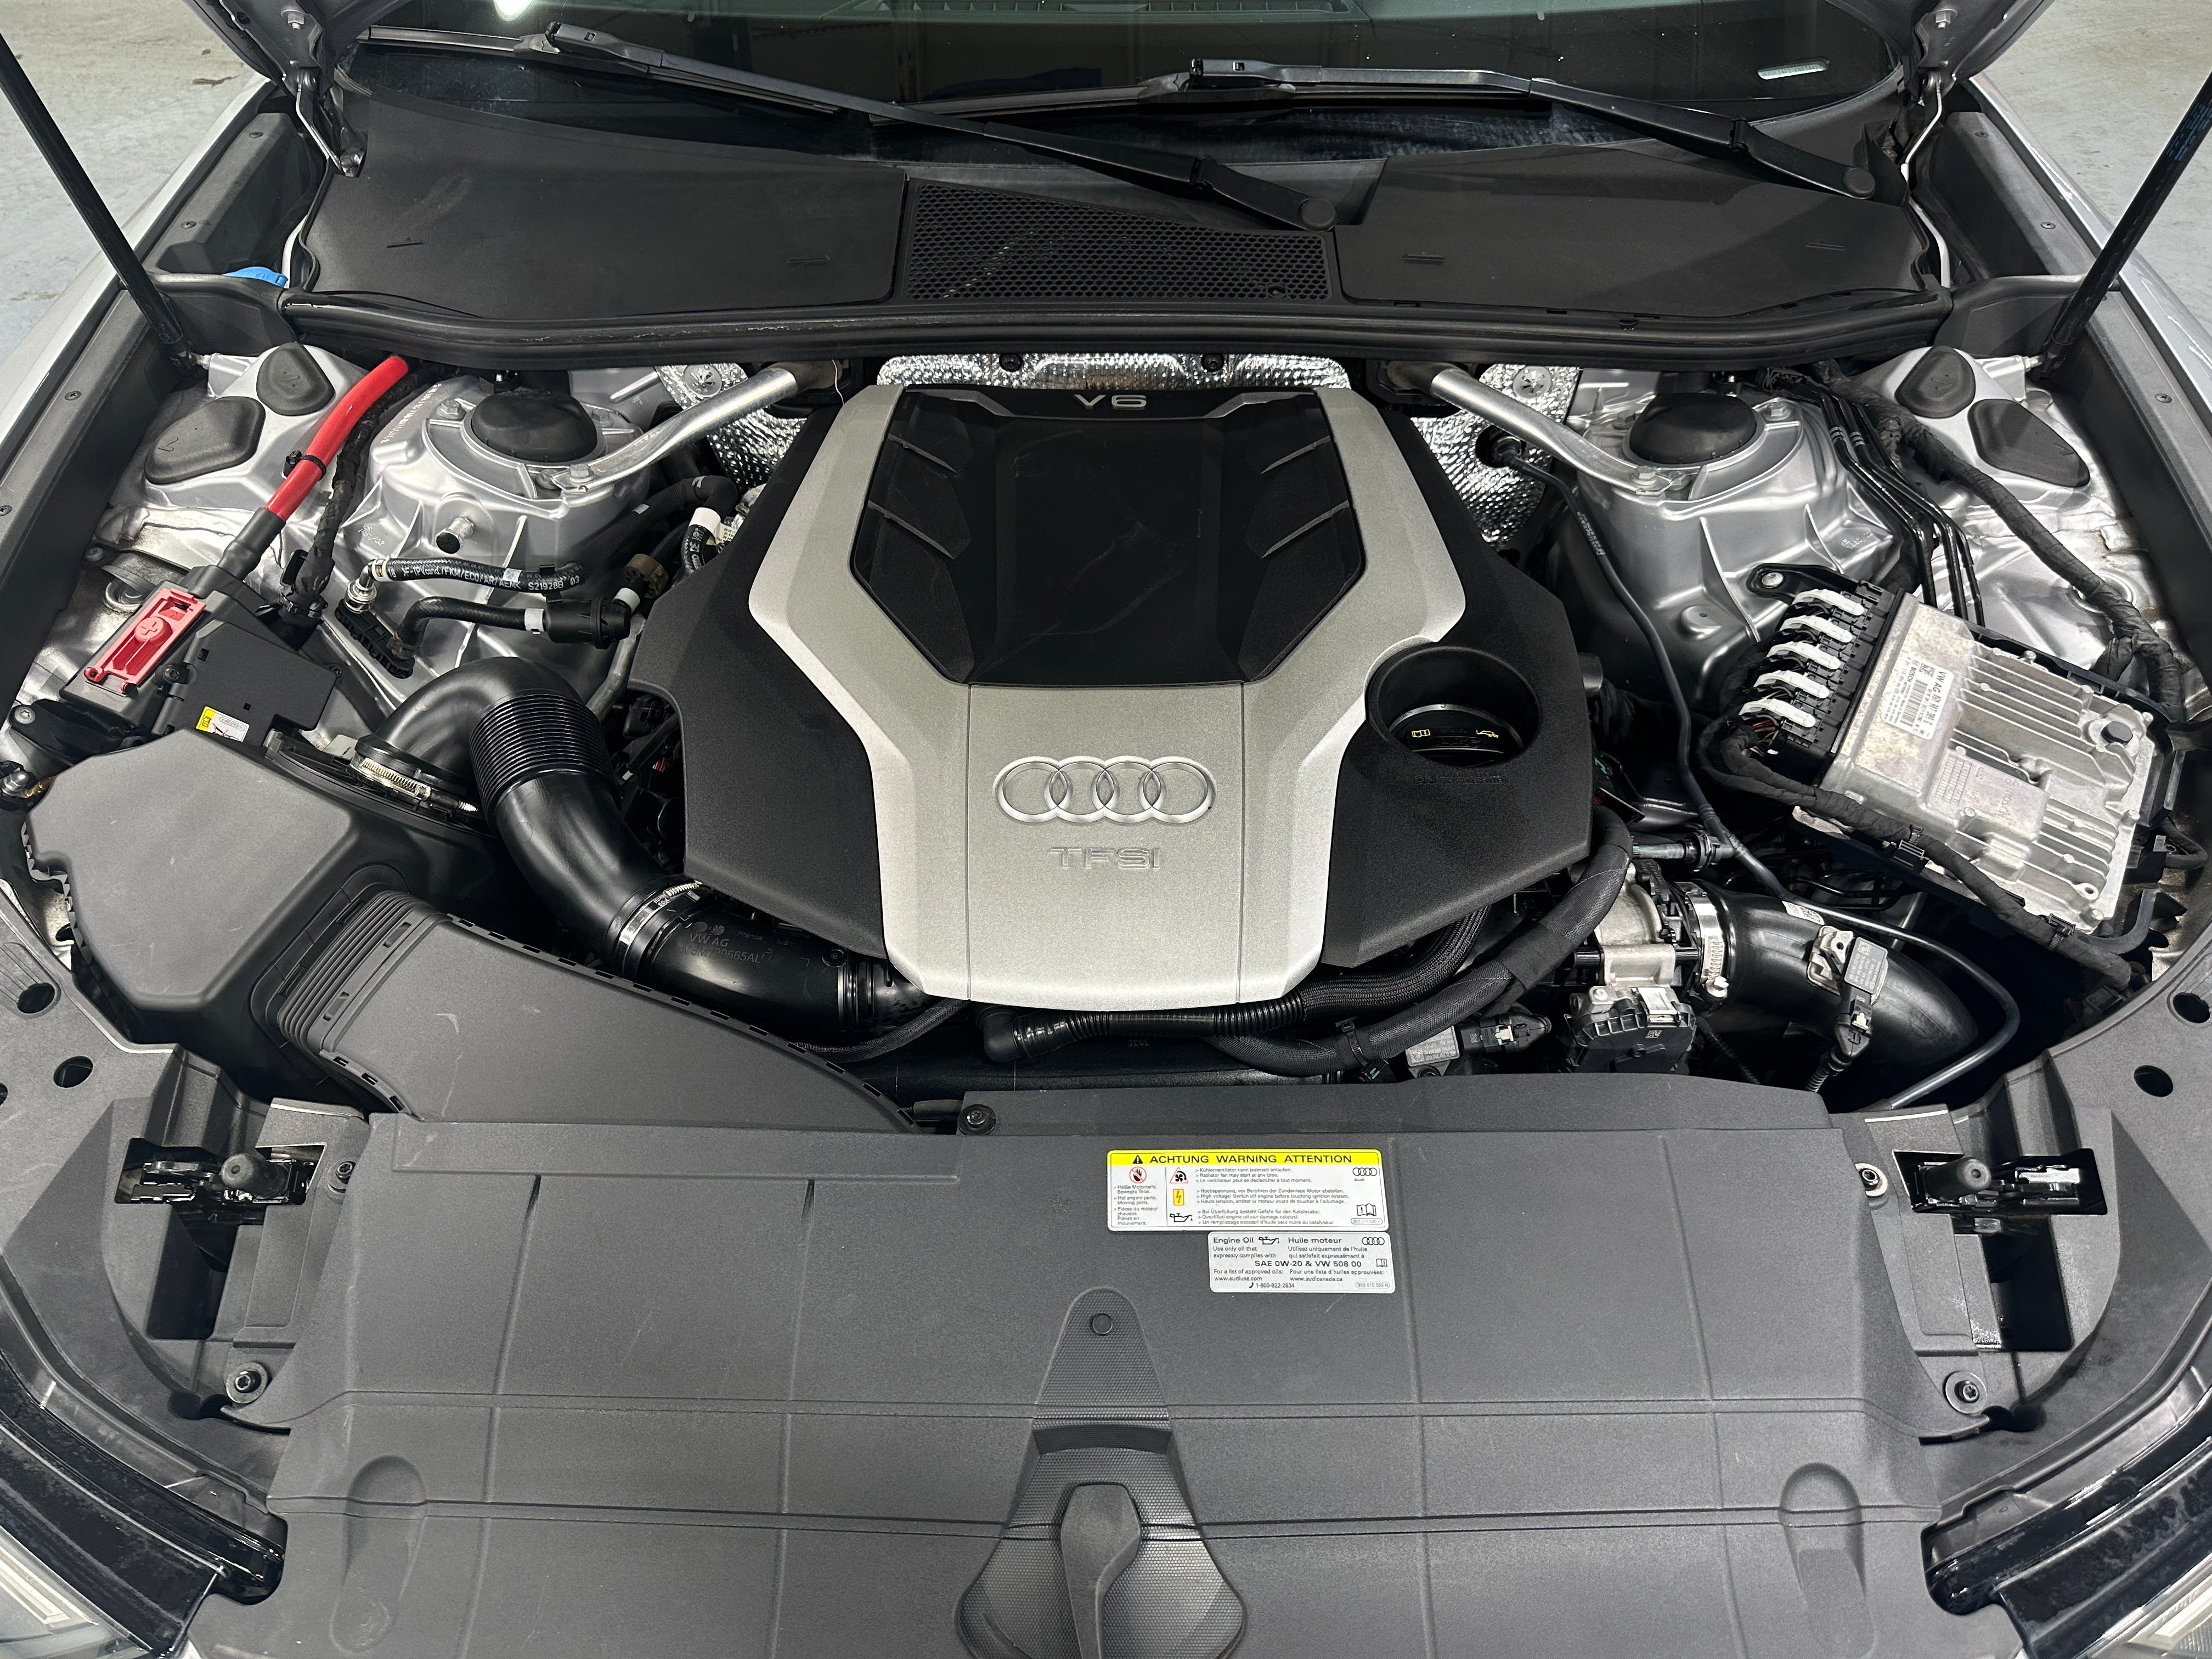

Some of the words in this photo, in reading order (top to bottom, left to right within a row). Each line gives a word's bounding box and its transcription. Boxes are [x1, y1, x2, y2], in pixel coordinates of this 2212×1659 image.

[1074, 394, 1147, 410] V6
[1906, 667, 1917, 682] BOSCH
[1936, 671, 1946, 683] VW
[1932, 681, 1942, 693] AG
[1048, 847, 1160, 869] TFSI
[690, 933, 712, 944] VW
[712, 938, 730, 947] AG
[737, 930, 764, 941] France
[1149, 1155, 1209, 1164] ACHTUNG
